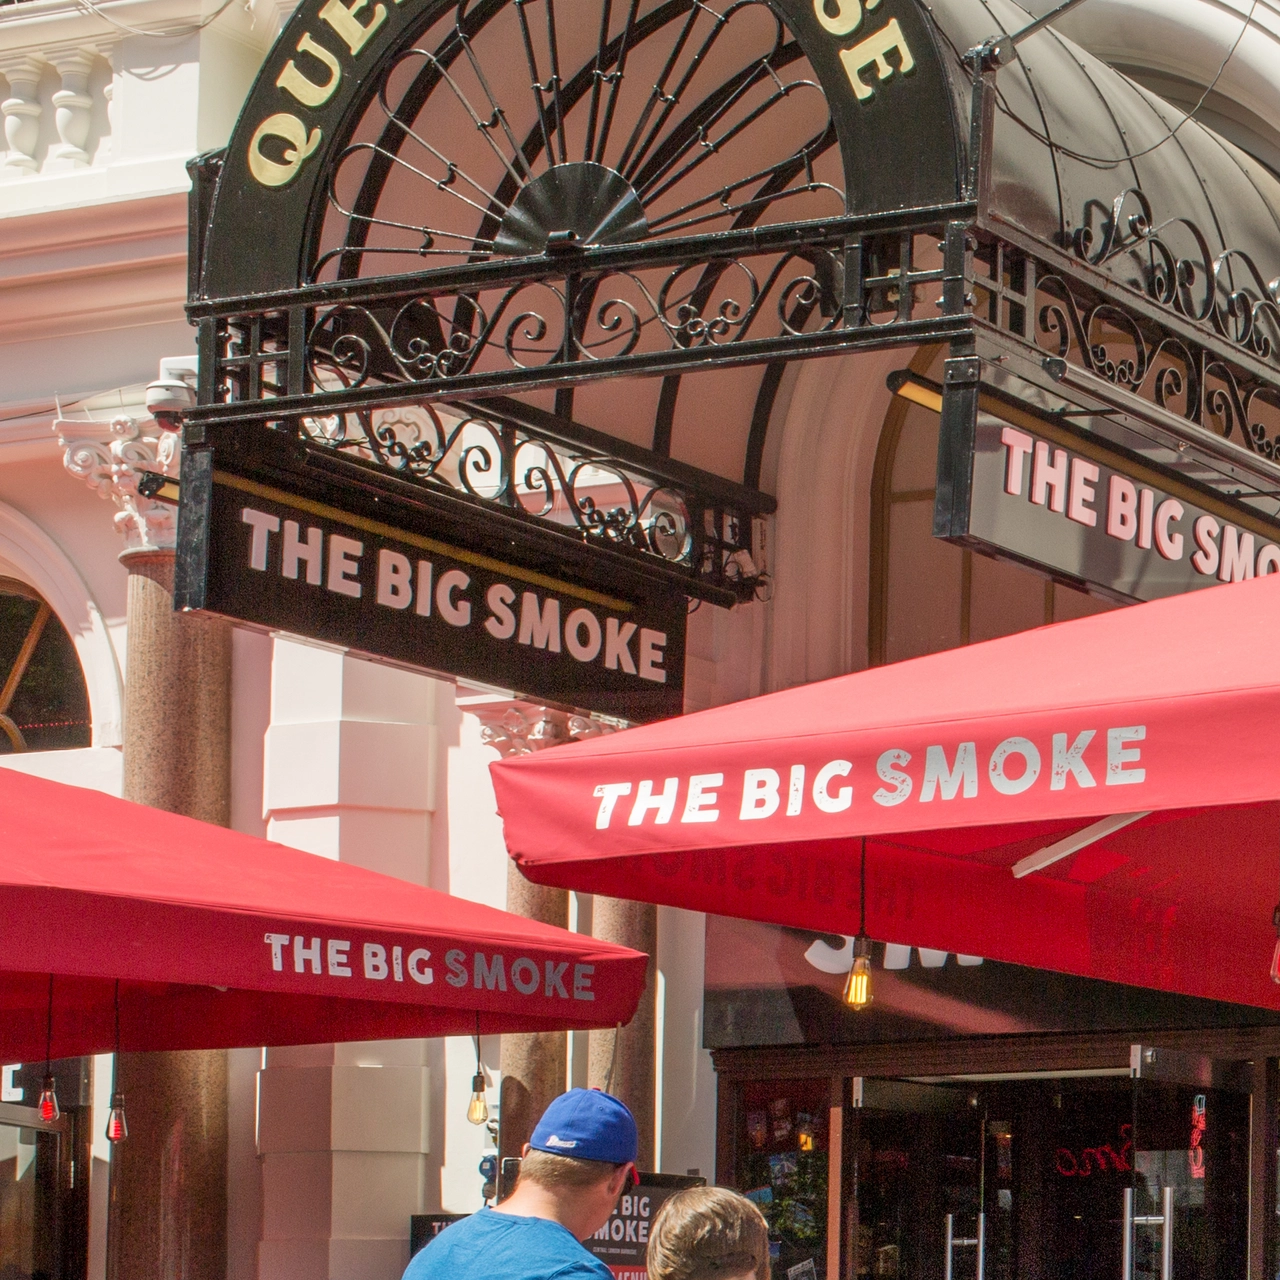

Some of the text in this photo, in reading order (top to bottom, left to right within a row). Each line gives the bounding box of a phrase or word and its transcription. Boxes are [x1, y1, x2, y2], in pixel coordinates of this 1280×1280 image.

[248, 0, 392, 187] QUE
[1001, 426, 1099, 528] THE
[1107, 474, 1184, 561] BIG
[242, 508, 667, 683] THE BIG SMOKE
[592, 724, 1147, 830] THE BIG SMOKE
[264, 933, 597, 1001] THE BIG SMOKE
[588, 1219, 649, 1243] MOKE
[622, 1195, 650, 1218] BIG
